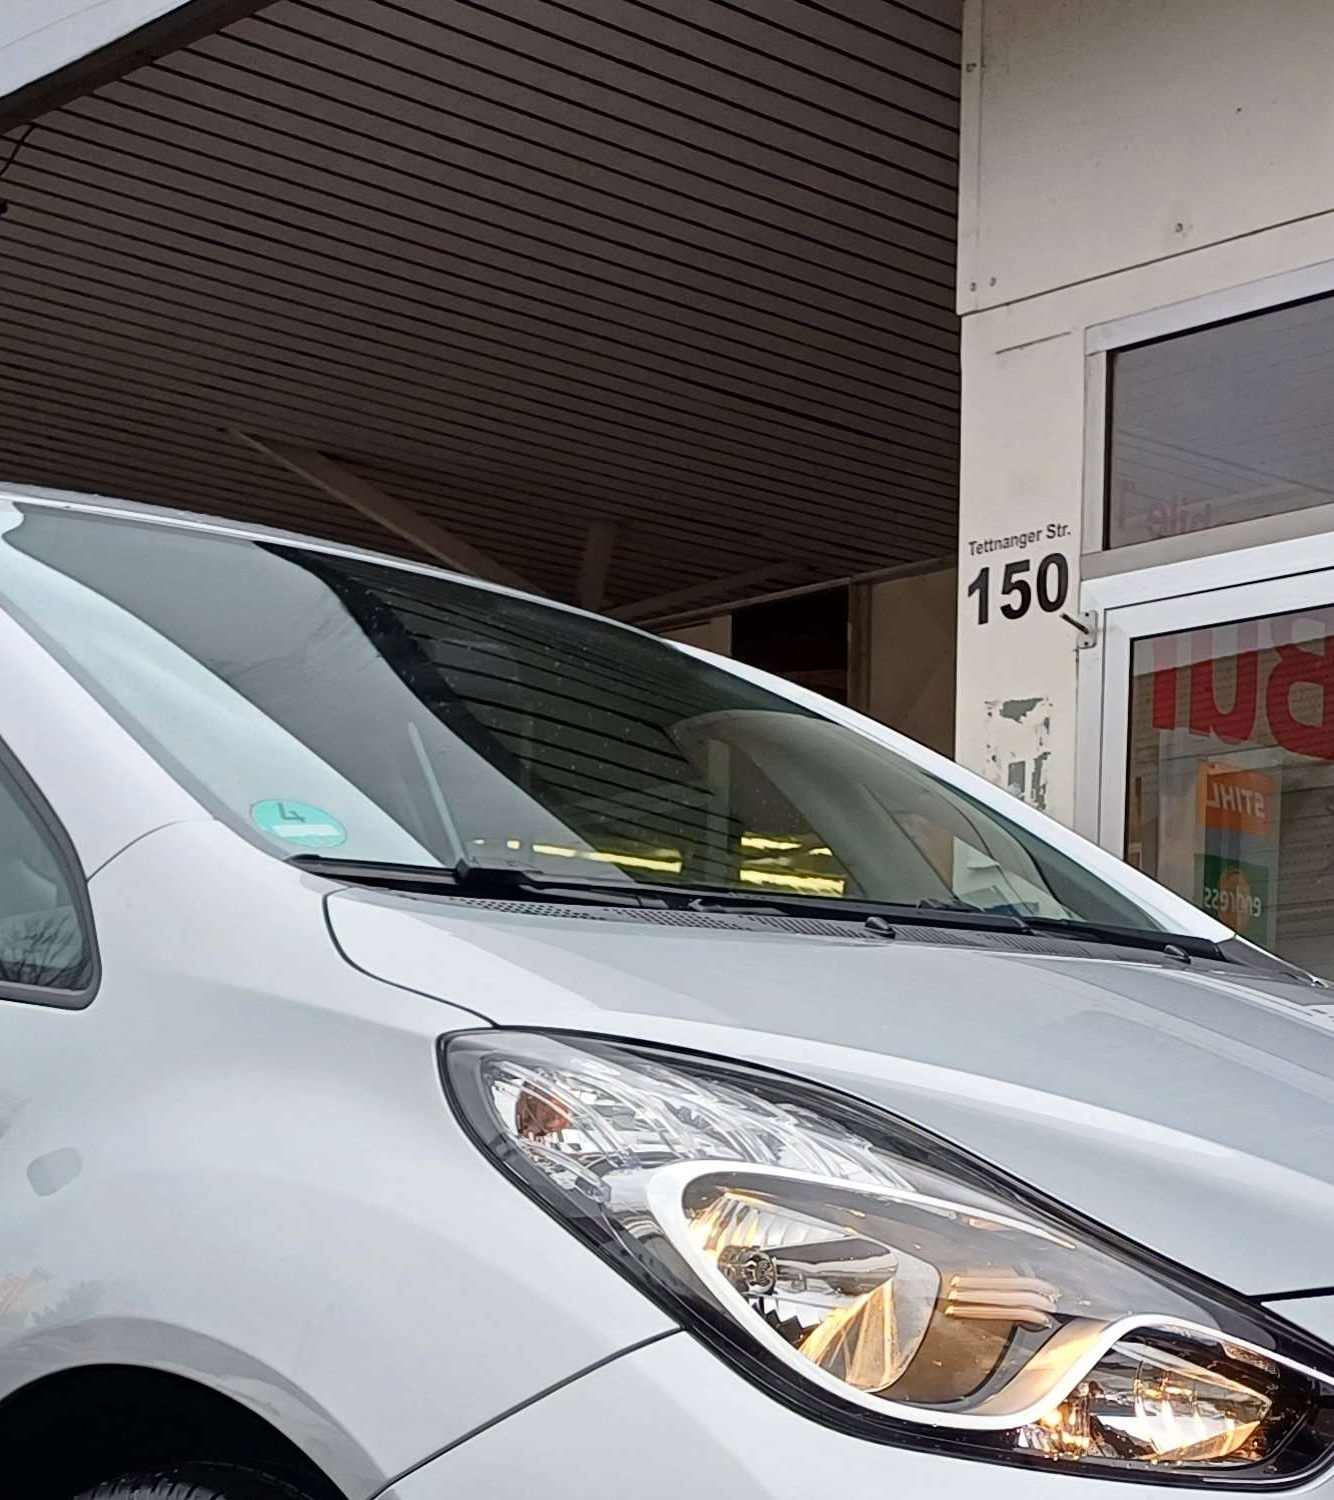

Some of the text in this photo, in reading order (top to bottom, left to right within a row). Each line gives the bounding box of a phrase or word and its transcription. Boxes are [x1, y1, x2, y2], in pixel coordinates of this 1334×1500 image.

[968, 523, 1071, 556] Tettnanger Str.
[968, 552, 1069, 625] 150
